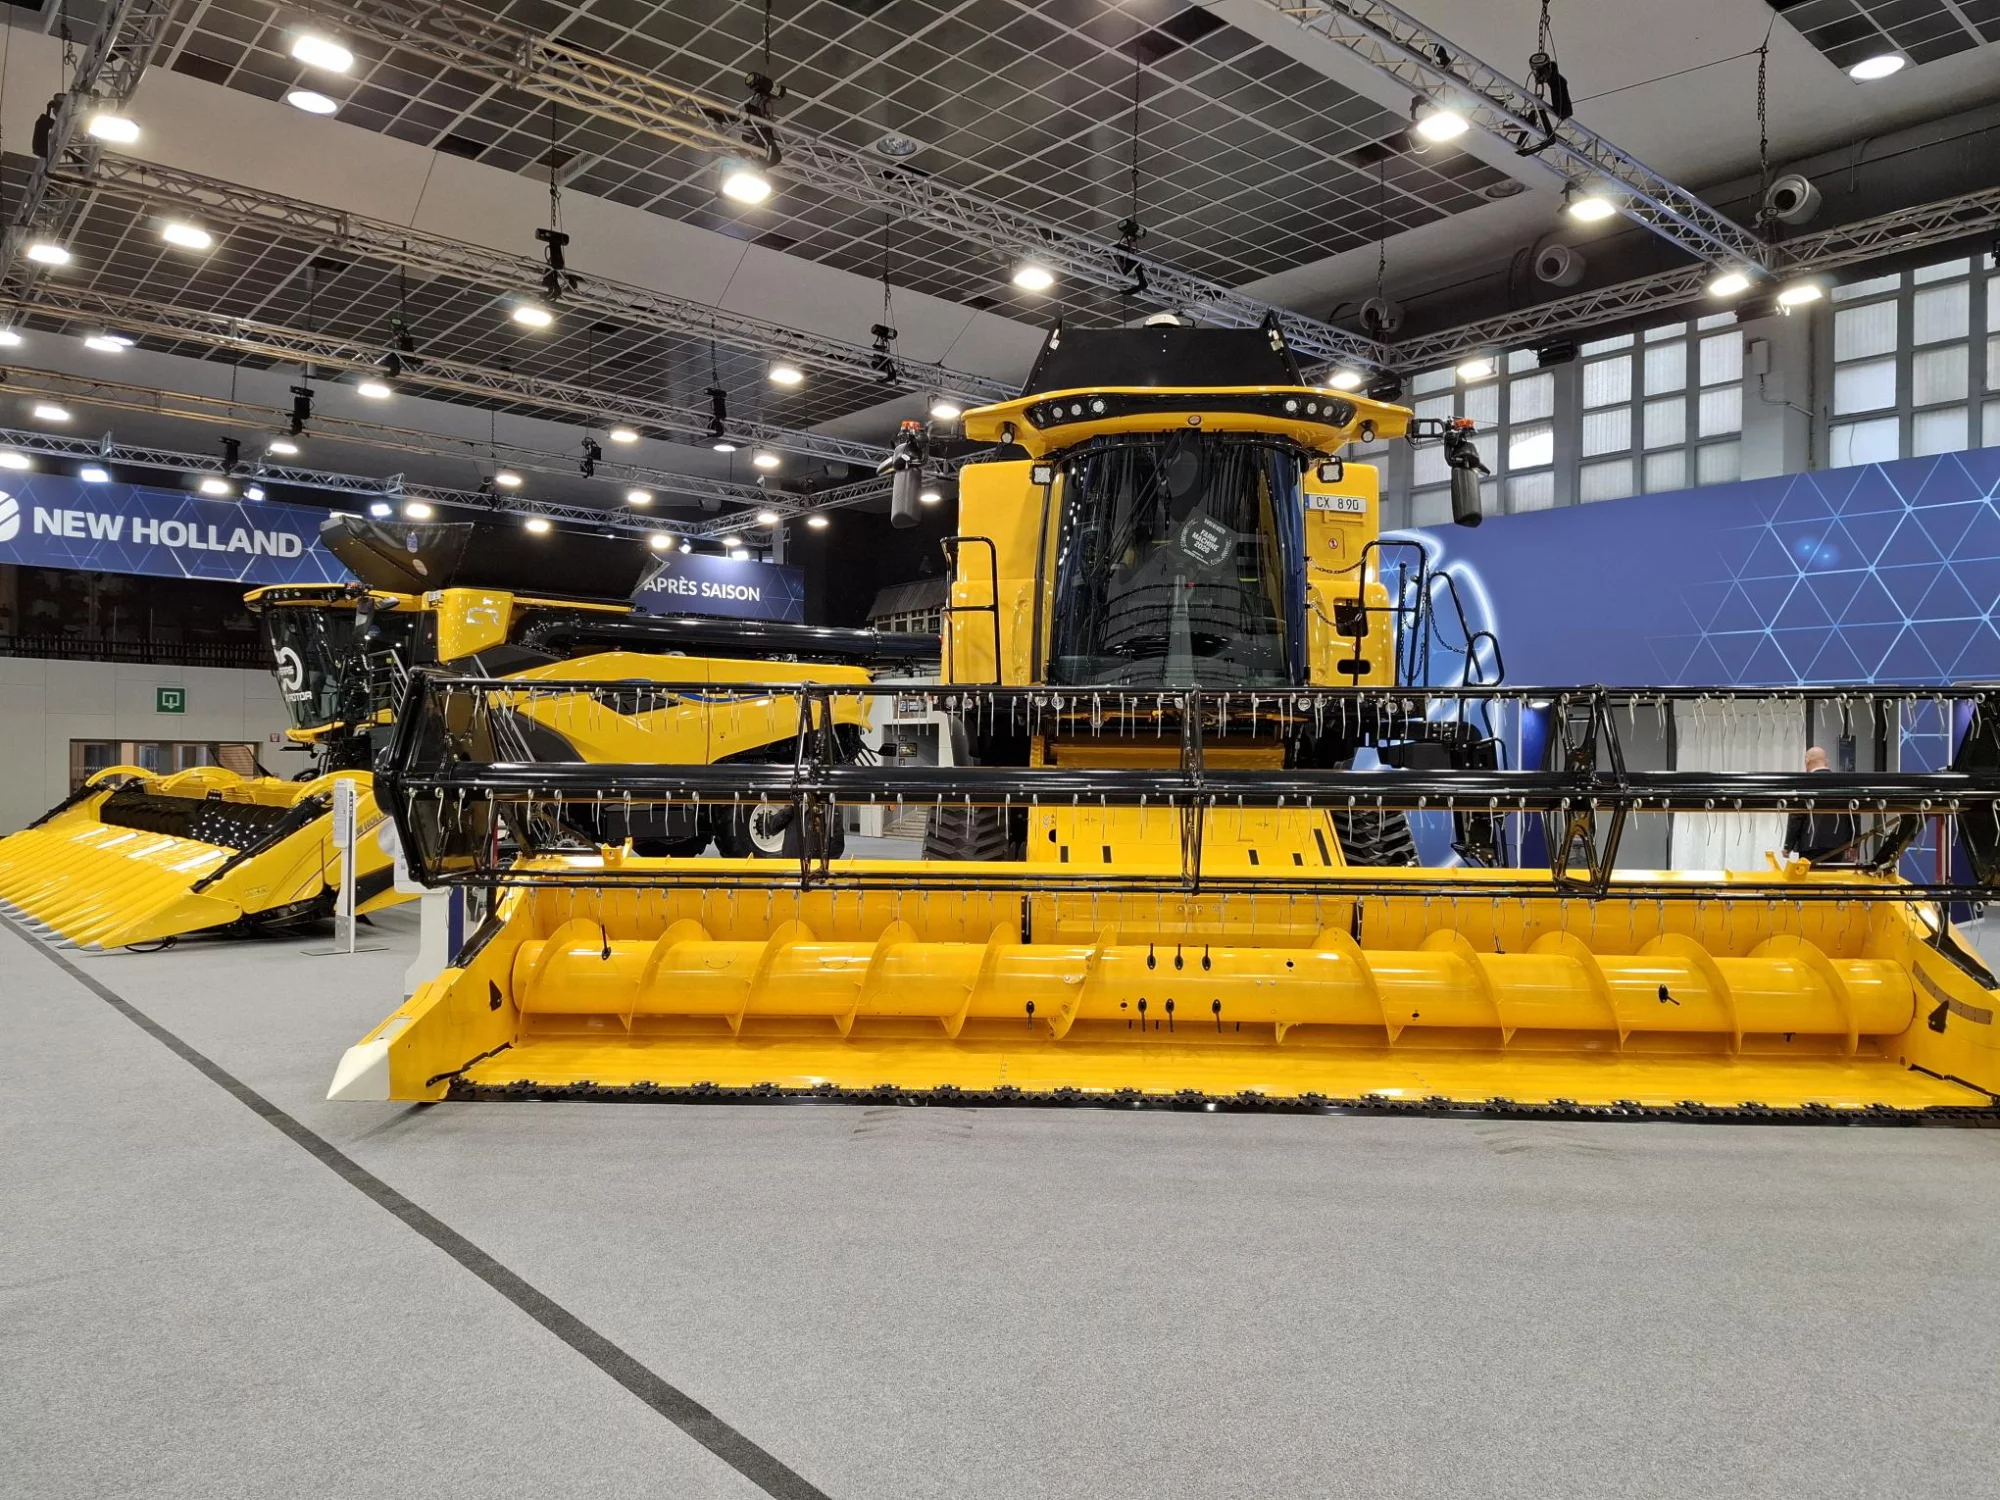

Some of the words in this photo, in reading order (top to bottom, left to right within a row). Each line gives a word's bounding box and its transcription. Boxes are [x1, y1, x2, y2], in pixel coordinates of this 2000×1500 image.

[1316, 496, 1330, 509] CX
[33, 506, 124, 541] NEW
[132, 517, 302, 558] HOLLAND
[1191, 531, 1220, 552] MACHINE
[1200, 529, 1218, 543] FARM
[643, 575, 697, 595] APRÈS
[701, 583, 760, 602] SAISON
